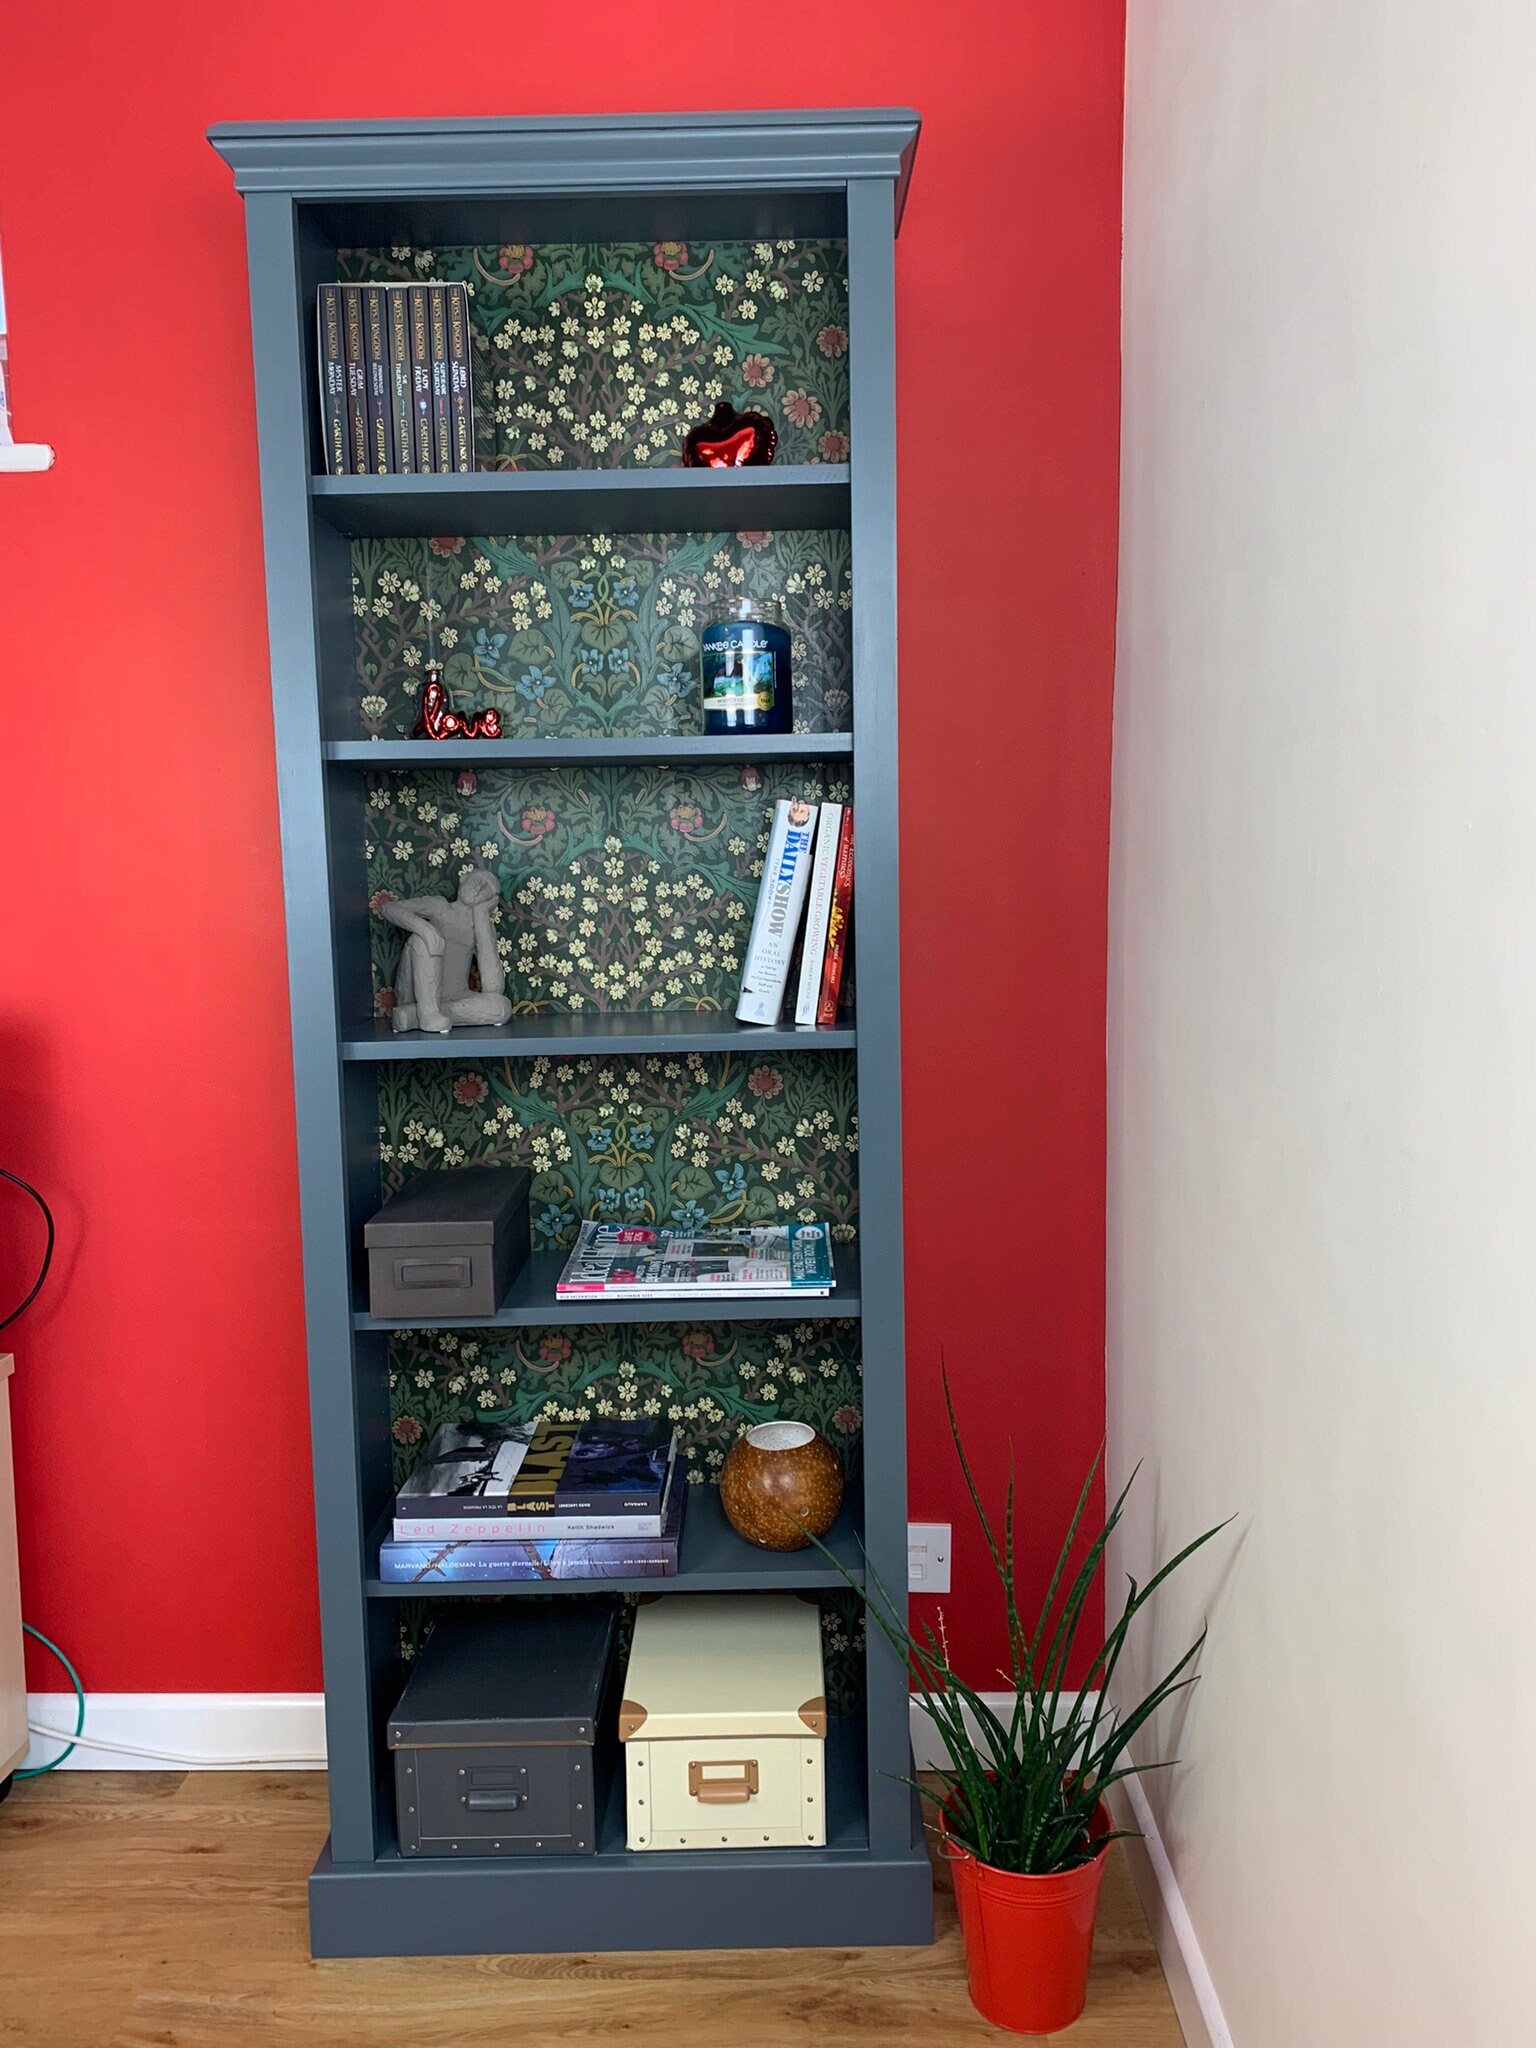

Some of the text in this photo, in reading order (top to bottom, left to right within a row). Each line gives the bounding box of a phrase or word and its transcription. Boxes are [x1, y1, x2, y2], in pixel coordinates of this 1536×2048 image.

[326, 298, 336, 316] KEYS
[348, 299, 357, 317] KEYS
[369, 299, 378, 317] KEYS
[393, 300, 403, 318] KEYS
[414, 298, 423, 317] KEYS
[432, 298, 441, 316] KEYS
[451, 297, 460, 315] KEYS
[328, 322, 338, 359] KINGDOM
[350, 323, 360, 360] KINGDOM
[371, 323, 381, 360] KINGDOM
[394, 324, 405, 360] KINGDOM
[415, 323, 426, 360] KINGDOM
[433, 323, 444, 359] KINGDOM
[452, 321, 462, 358] KINGDOM
[327, 361, 336, 395] MONDAY
[349, 363, 358, 397] TUESDAY
[415, 366, 423, 393] FRIDAY
[451, 361, 461, 394] SUNDAY
[459, 367, 467, 388] LORD
[333, 419, 341, 447] GARTH
[376, 418, 386, 462] GARTH NIX
[400, 419, 409, 463] GARTH NIX
[420, 418, 429, 462] GARTH NIX
[439, 417, 447, 447] GARTH
[458, 416, 466, 446] GARTH
[799, 831, 810, 854] THE
[810, 812, 834, 955] ORGANIC VEGETABLE GROWING
[754, 955, 786, 966] HISTORY
[569, 1259, 614, 1283] Ideal
[510, 1422, 581, 1495] BLAST
[507, 1501, 555, 1511] BLAST
[400, 1524, 435, 1535] Led
[450, 1523, 545, 1536] Zeppelin
[488, 1561, 511, 1569] guerre
